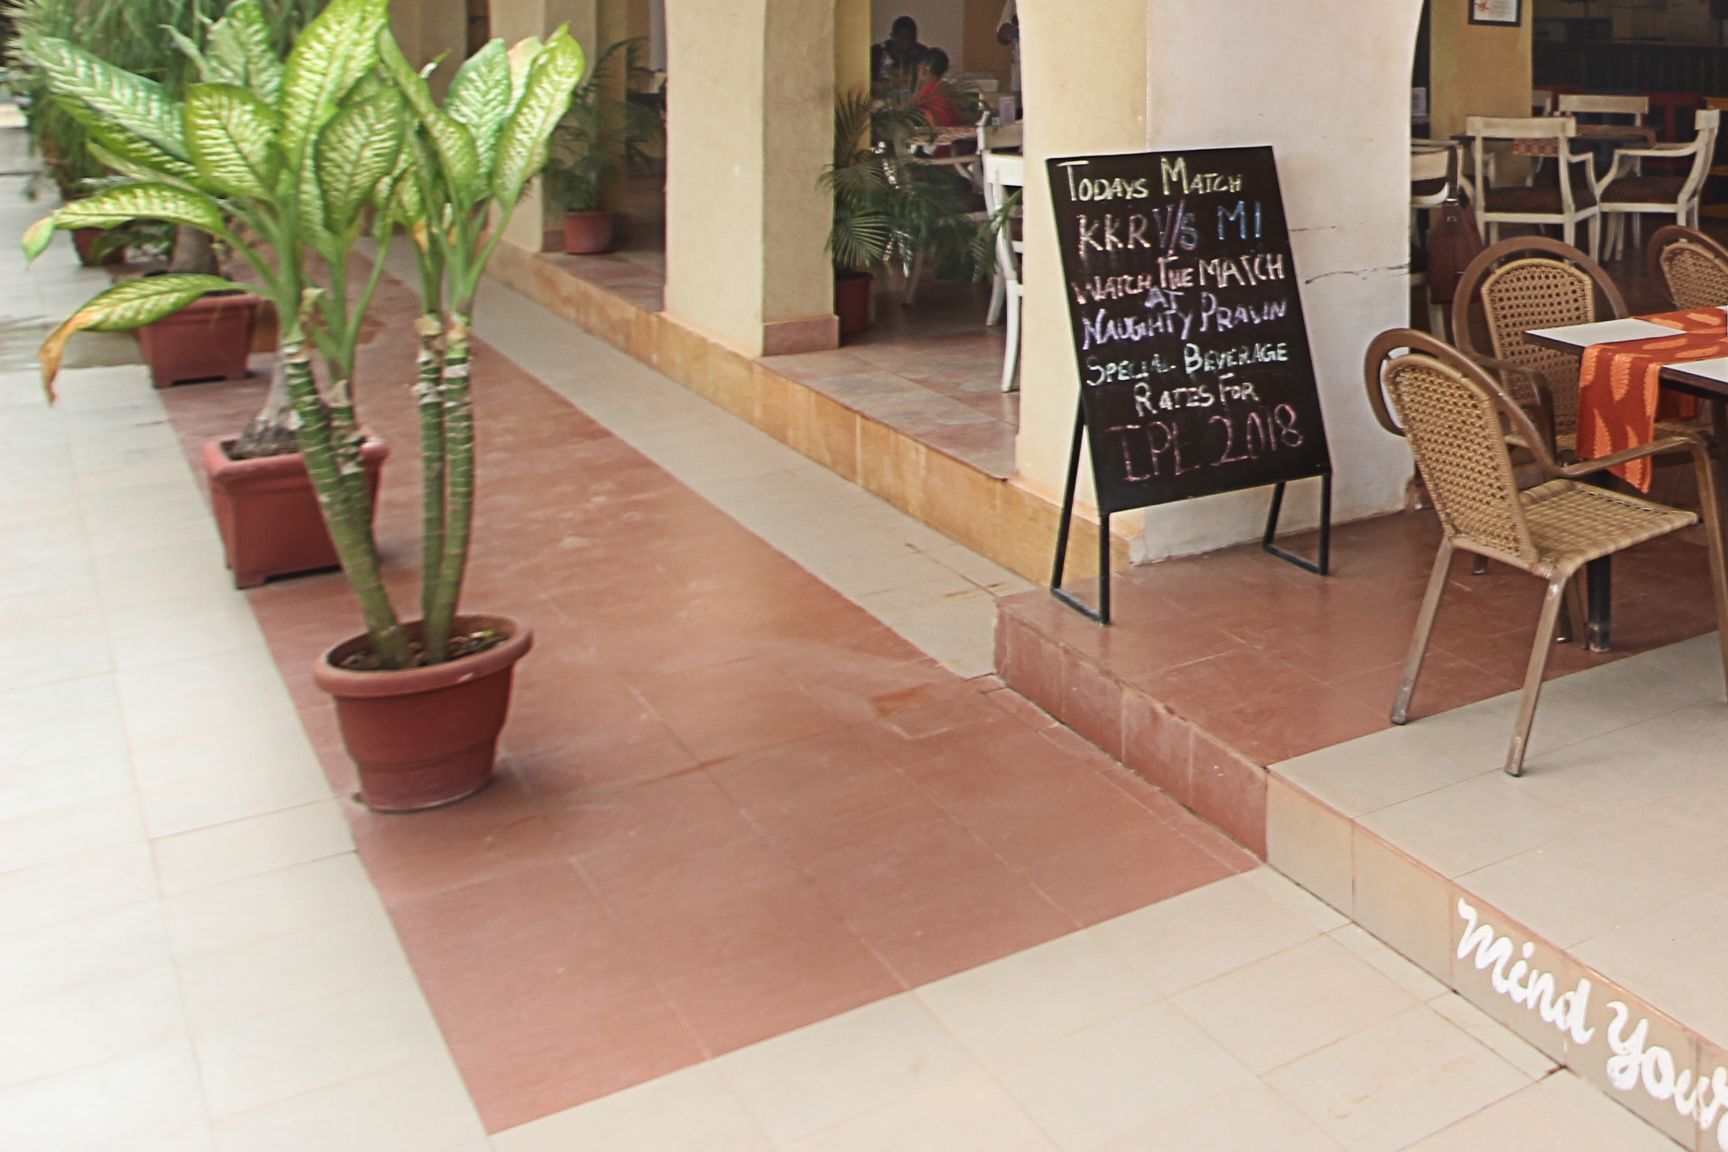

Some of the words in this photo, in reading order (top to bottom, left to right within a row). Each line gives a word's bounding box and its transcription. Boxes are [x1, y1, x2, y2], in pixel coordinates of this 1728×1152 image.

[1056, 159, 1149, 202] TODAYS
[1160, 156, 1243, 196] MATCH
[1076, 213, 1151, 256] KKR
[1216, 200, 1262, 240] MI
[1071, 274, 1151, 304] WATCH
[1157, 253, 1194, 289] THE
[1199, 253, 1286, 287] MATCH
[1144, 285, 1185, 312] AT
[1082, 308, 1194, 350] NAUGHTY
[1200, 292, 1287, 332] PRAWN
[1184, 342, 1289, 375] BEVERAGE
[1134, 381, 1215, 417] RATES
[1218, 373, 1260, 404] FOR
[1105, 421, 1200, 482] IPL
[1208, 403, 1304, 467] 2018
